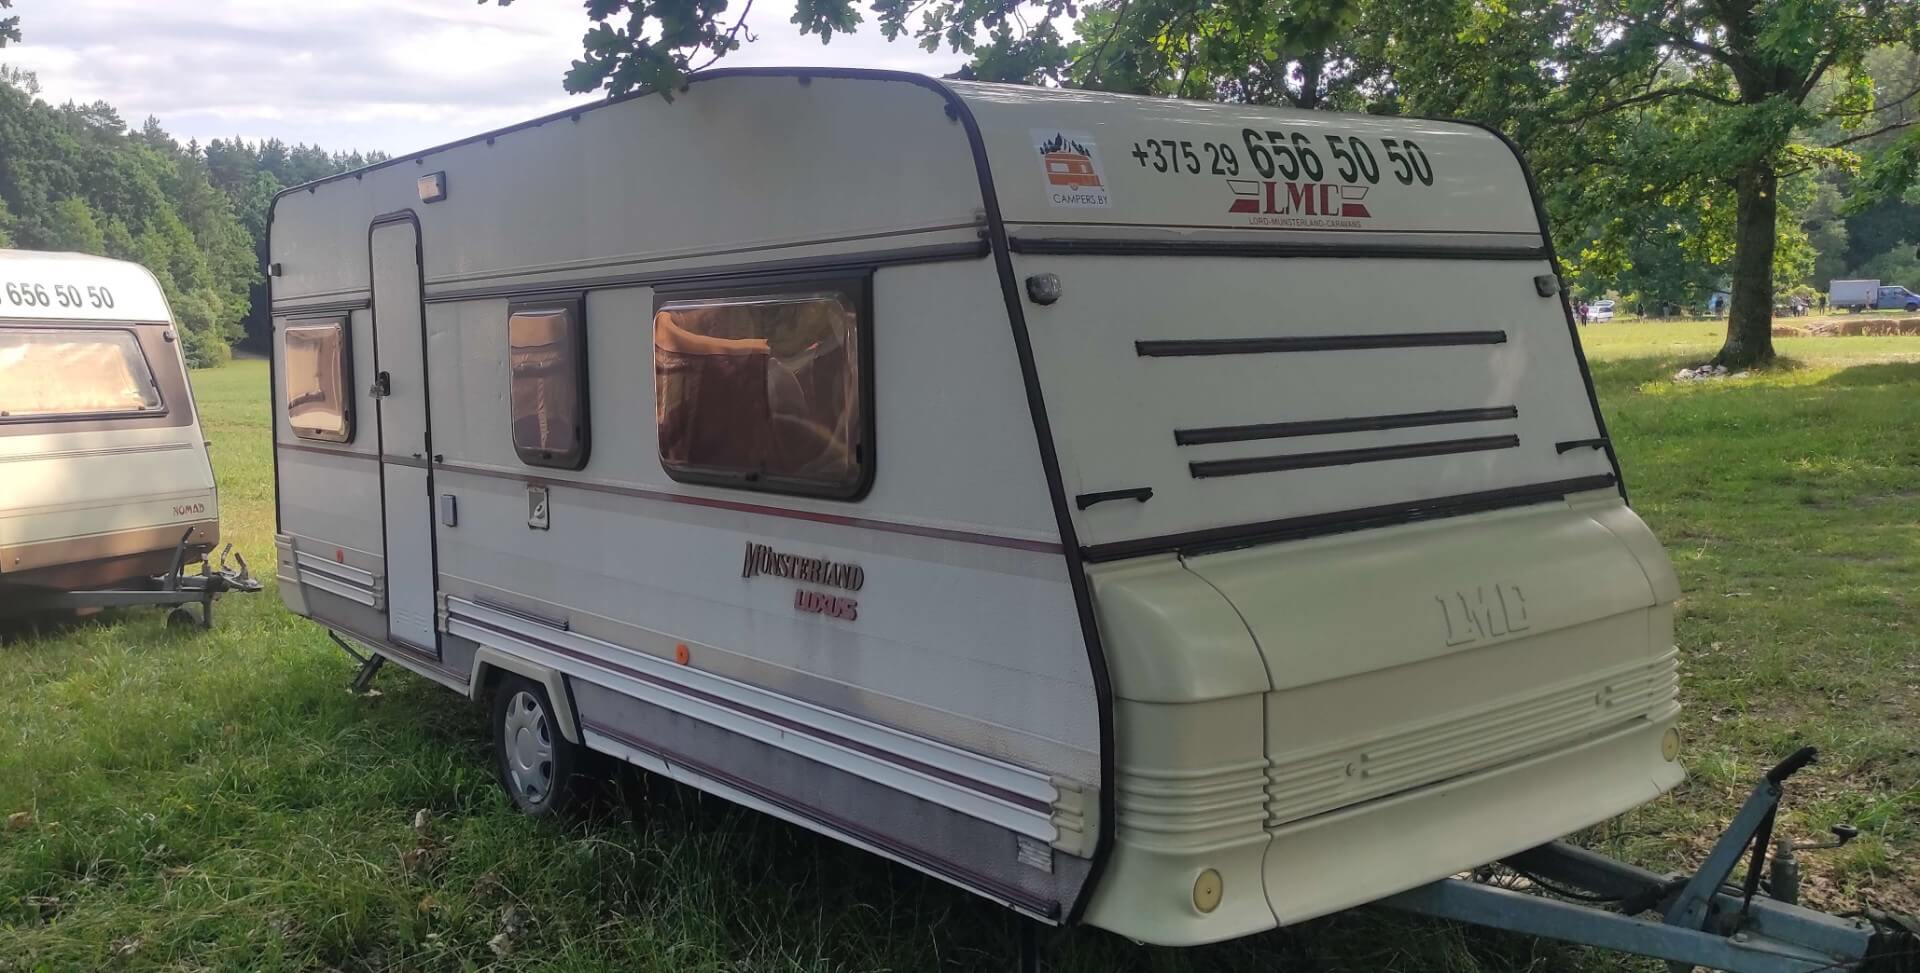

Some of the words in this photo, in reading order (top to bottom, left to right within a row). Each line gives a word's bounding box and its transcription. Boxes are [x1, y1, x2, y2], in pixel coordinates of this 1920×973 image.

[1132, 138, 1201, 174] +375
[1204, 142, 1239, 176] 29
[1242, 128, 1324, 182] 656
[1325, 134, 1380, 184] 50
[1380, 138, 1434, 187] 50
[1052, 193, 1108, 205] CAMPERS.BY
[1262, 181, 1340, 216] LMC
[6, 282, 50, 307] 656
[54, 284, 83, 308] 50
[86, 285, 115, 309] 50
[172, 503, 205, 516] NOMAD
[793, 589, 858, 621] LUXUS
